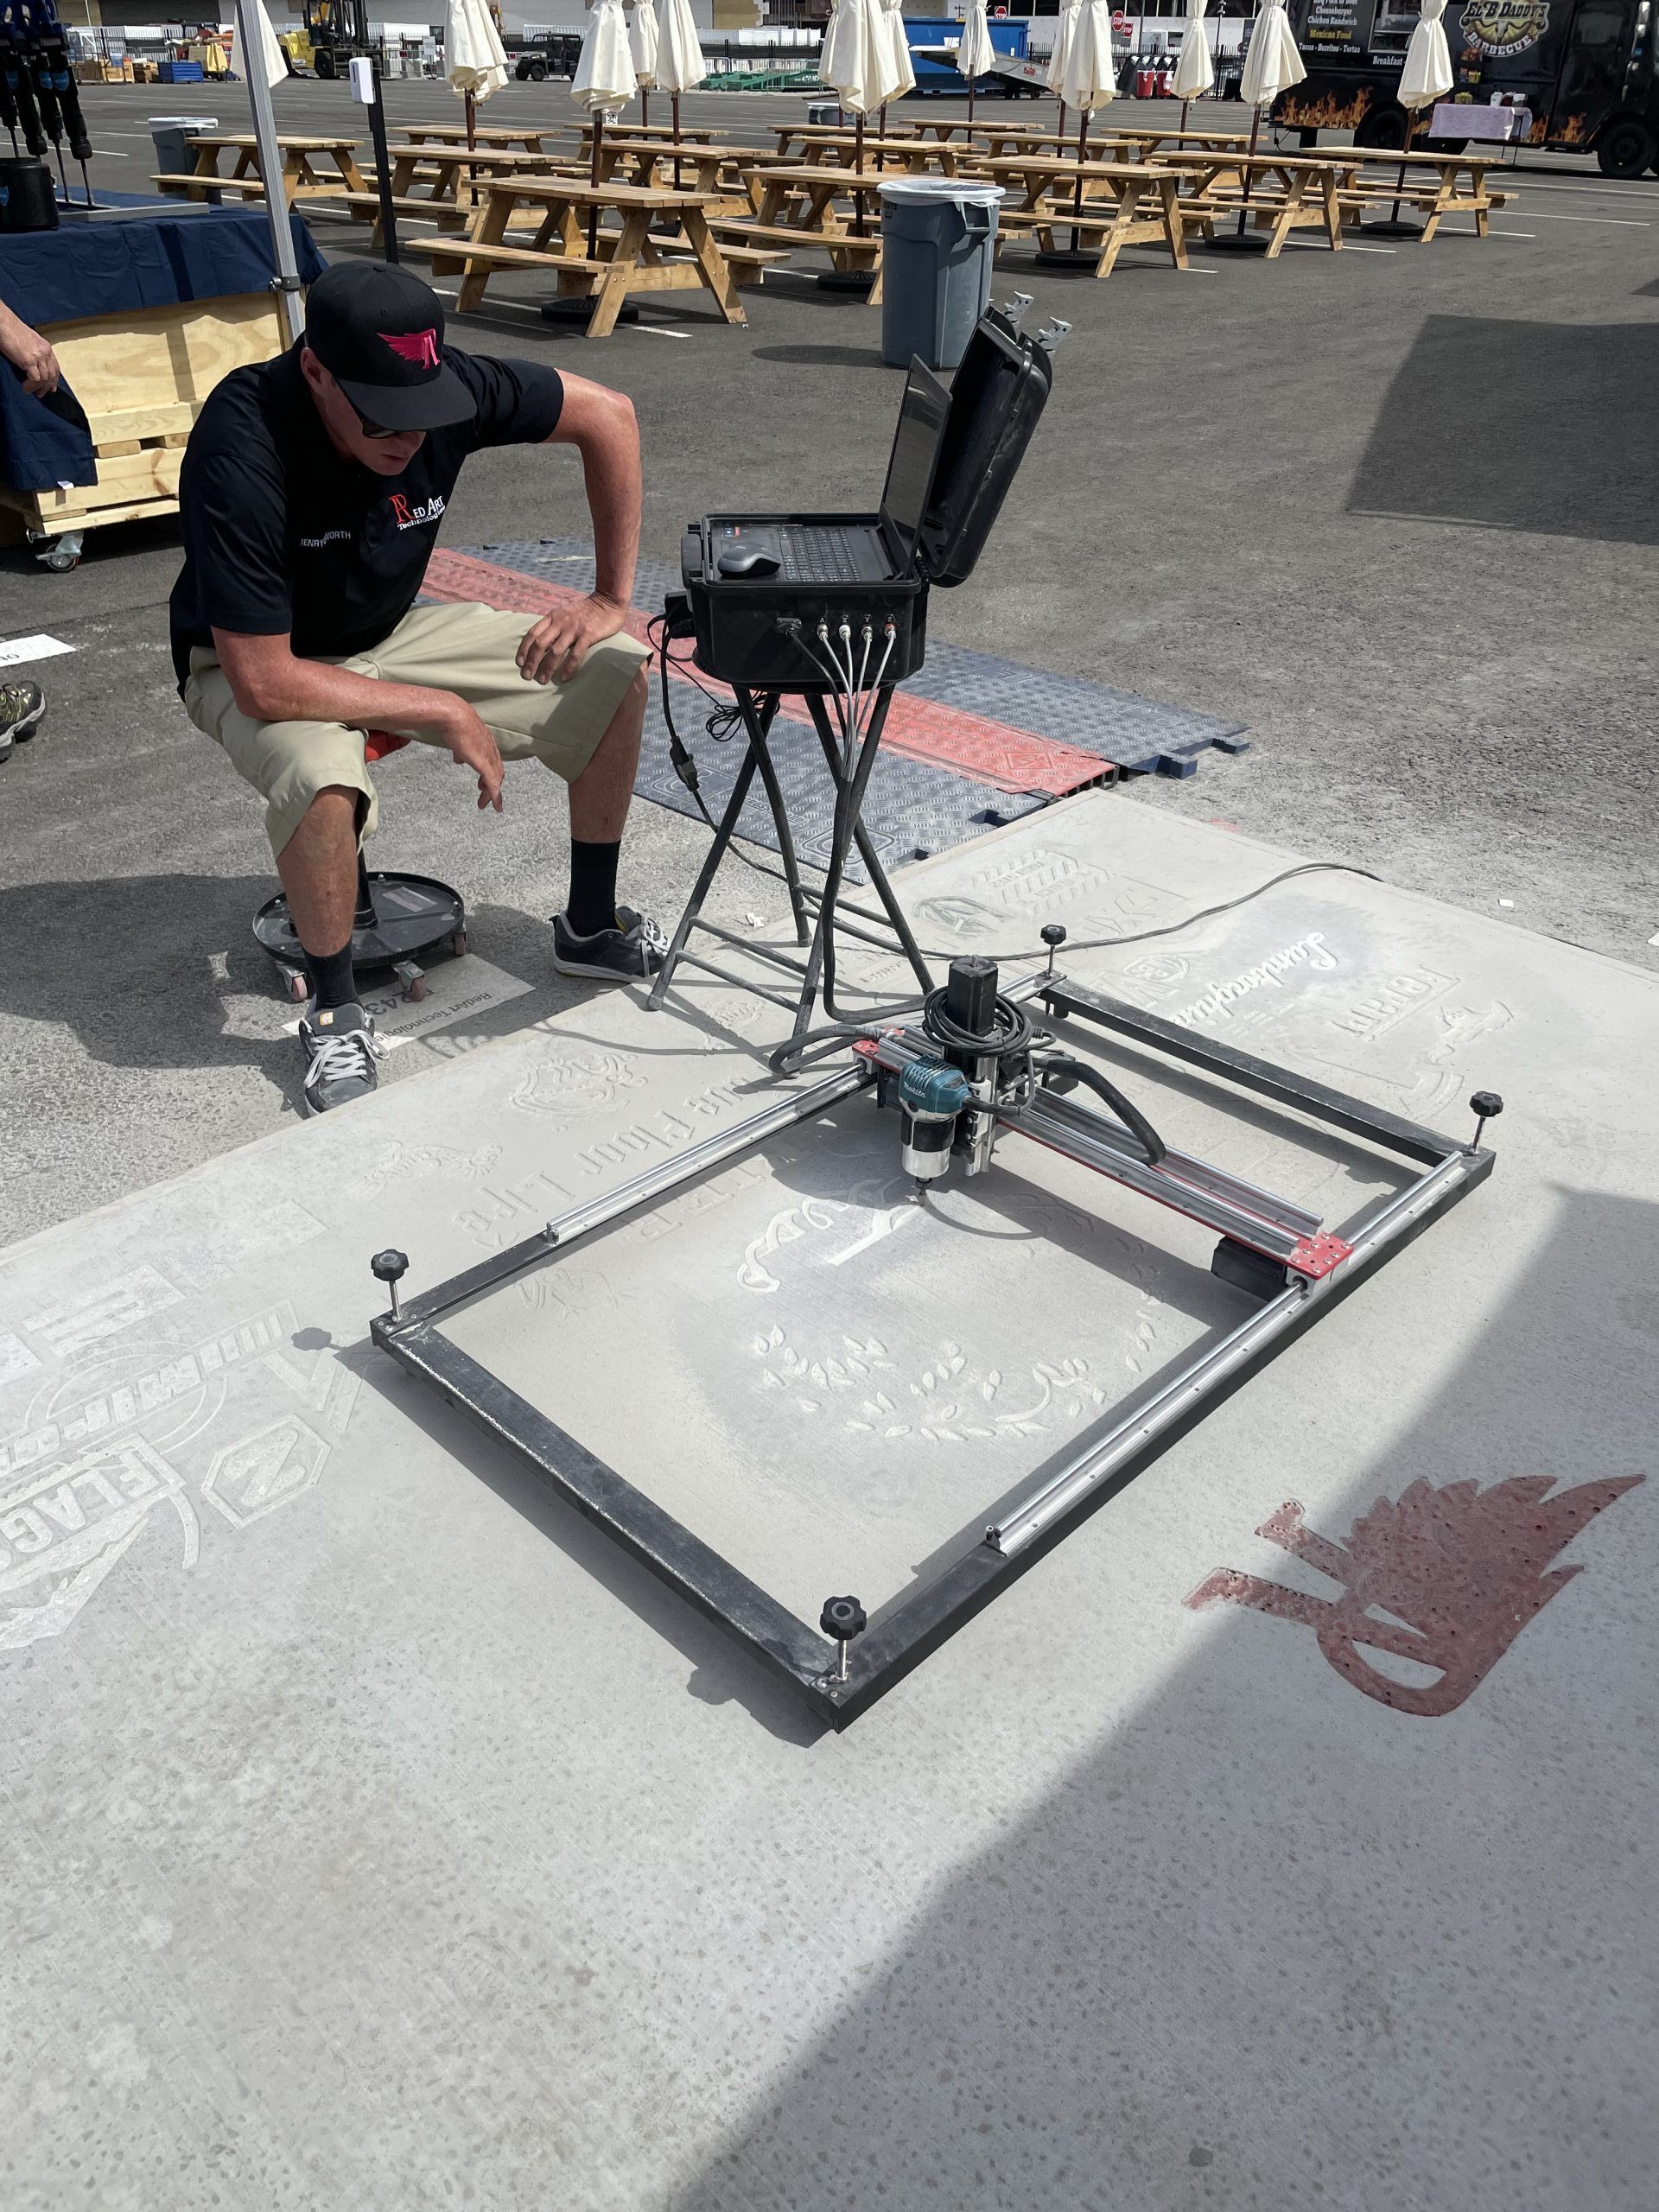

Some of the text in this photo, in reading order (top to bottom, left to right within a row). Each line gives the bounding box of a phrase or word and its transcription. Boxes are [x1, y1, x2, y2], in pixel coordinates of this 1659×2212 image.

[1315, 5, 1353, 16] Cheeseburger
[1113, 16, 1124, 25] STOP
[1307, 16, 1357, 26] Chicken Sandwich
[1309, 29, 1352, 40] Mexican Food
[1299, 41, 1314, 51] Tacos
[1467, 32, 1532, 55] BARBECUE
[1372, 55, 1404, 66] Breakfast
[1172, 931, 1338, 1028] Lamborghin
[374, 992, 493, 1042] RedArt Technologie
[0, 1448, 161, 1568] FLAG
